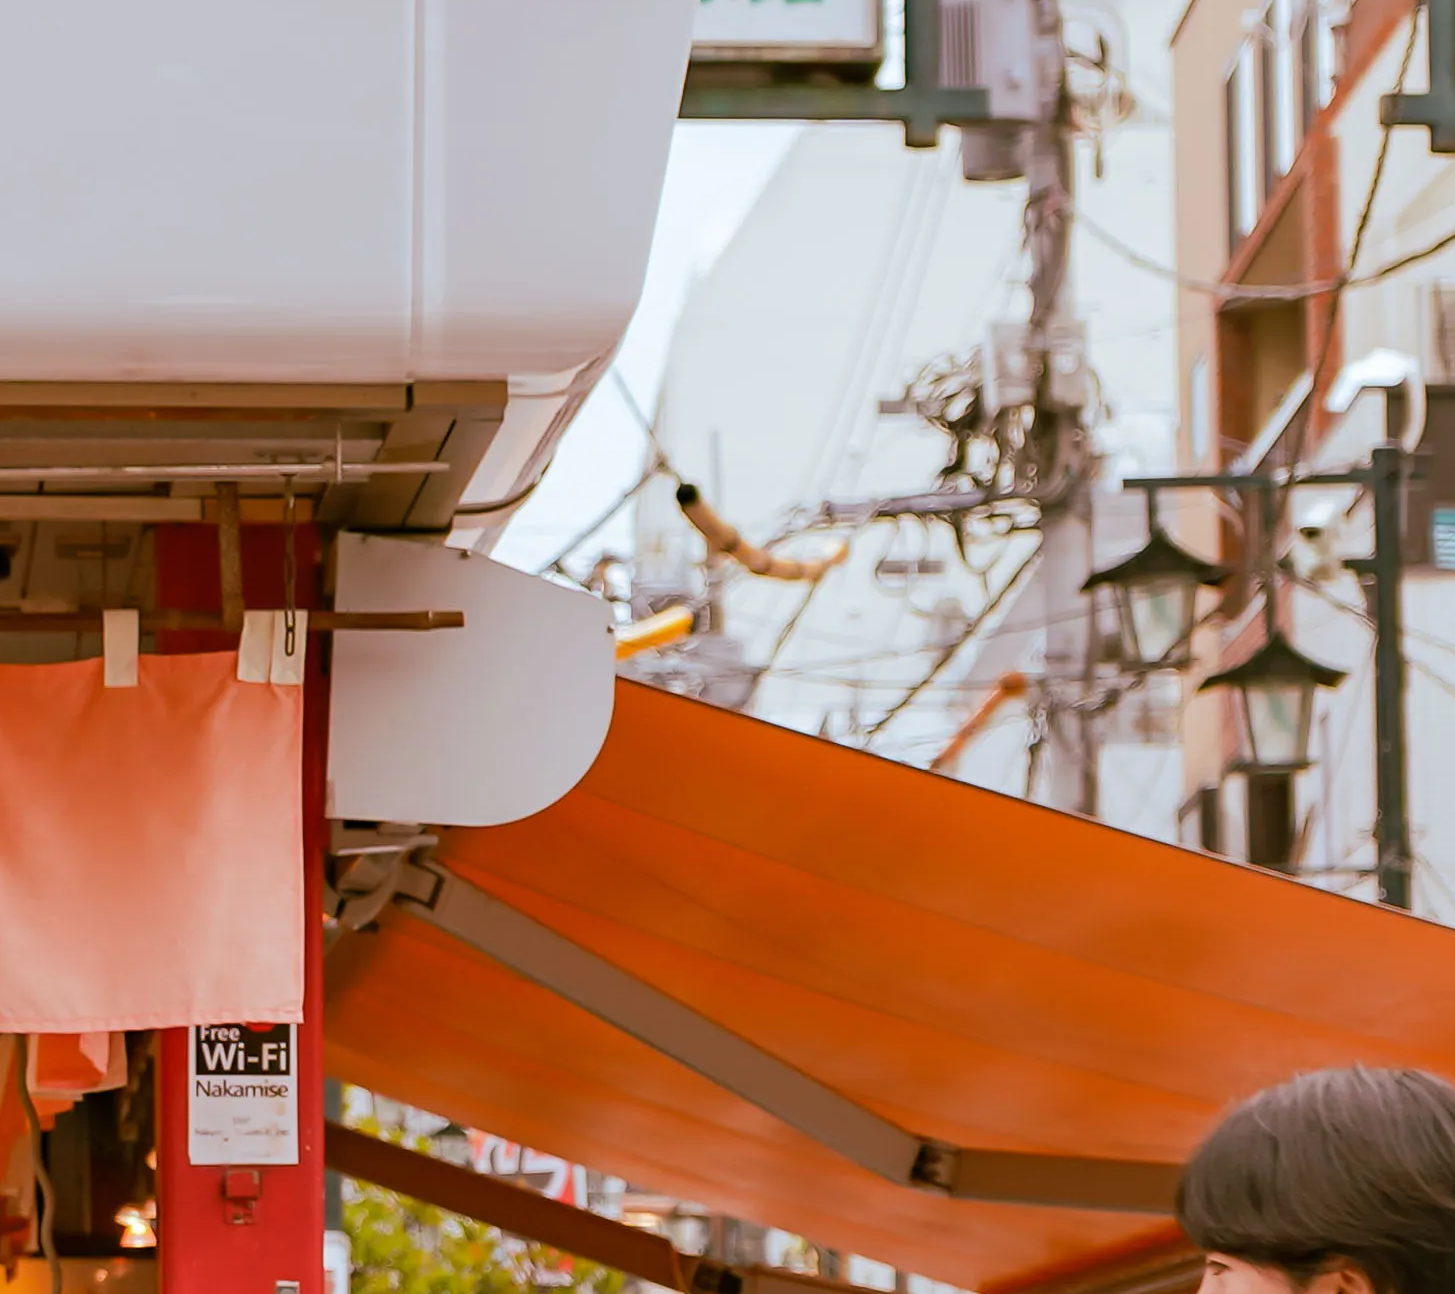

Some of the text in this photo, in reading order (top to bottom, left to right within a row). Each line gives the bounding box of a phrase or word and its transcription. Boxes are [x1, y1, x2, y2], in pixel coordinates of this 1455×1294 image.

[200, 1025, 241, 1042] Free
[201, 1042, 287, 1071] Wi-Fi
[195, 1079, 289, 1098] Nakamise
